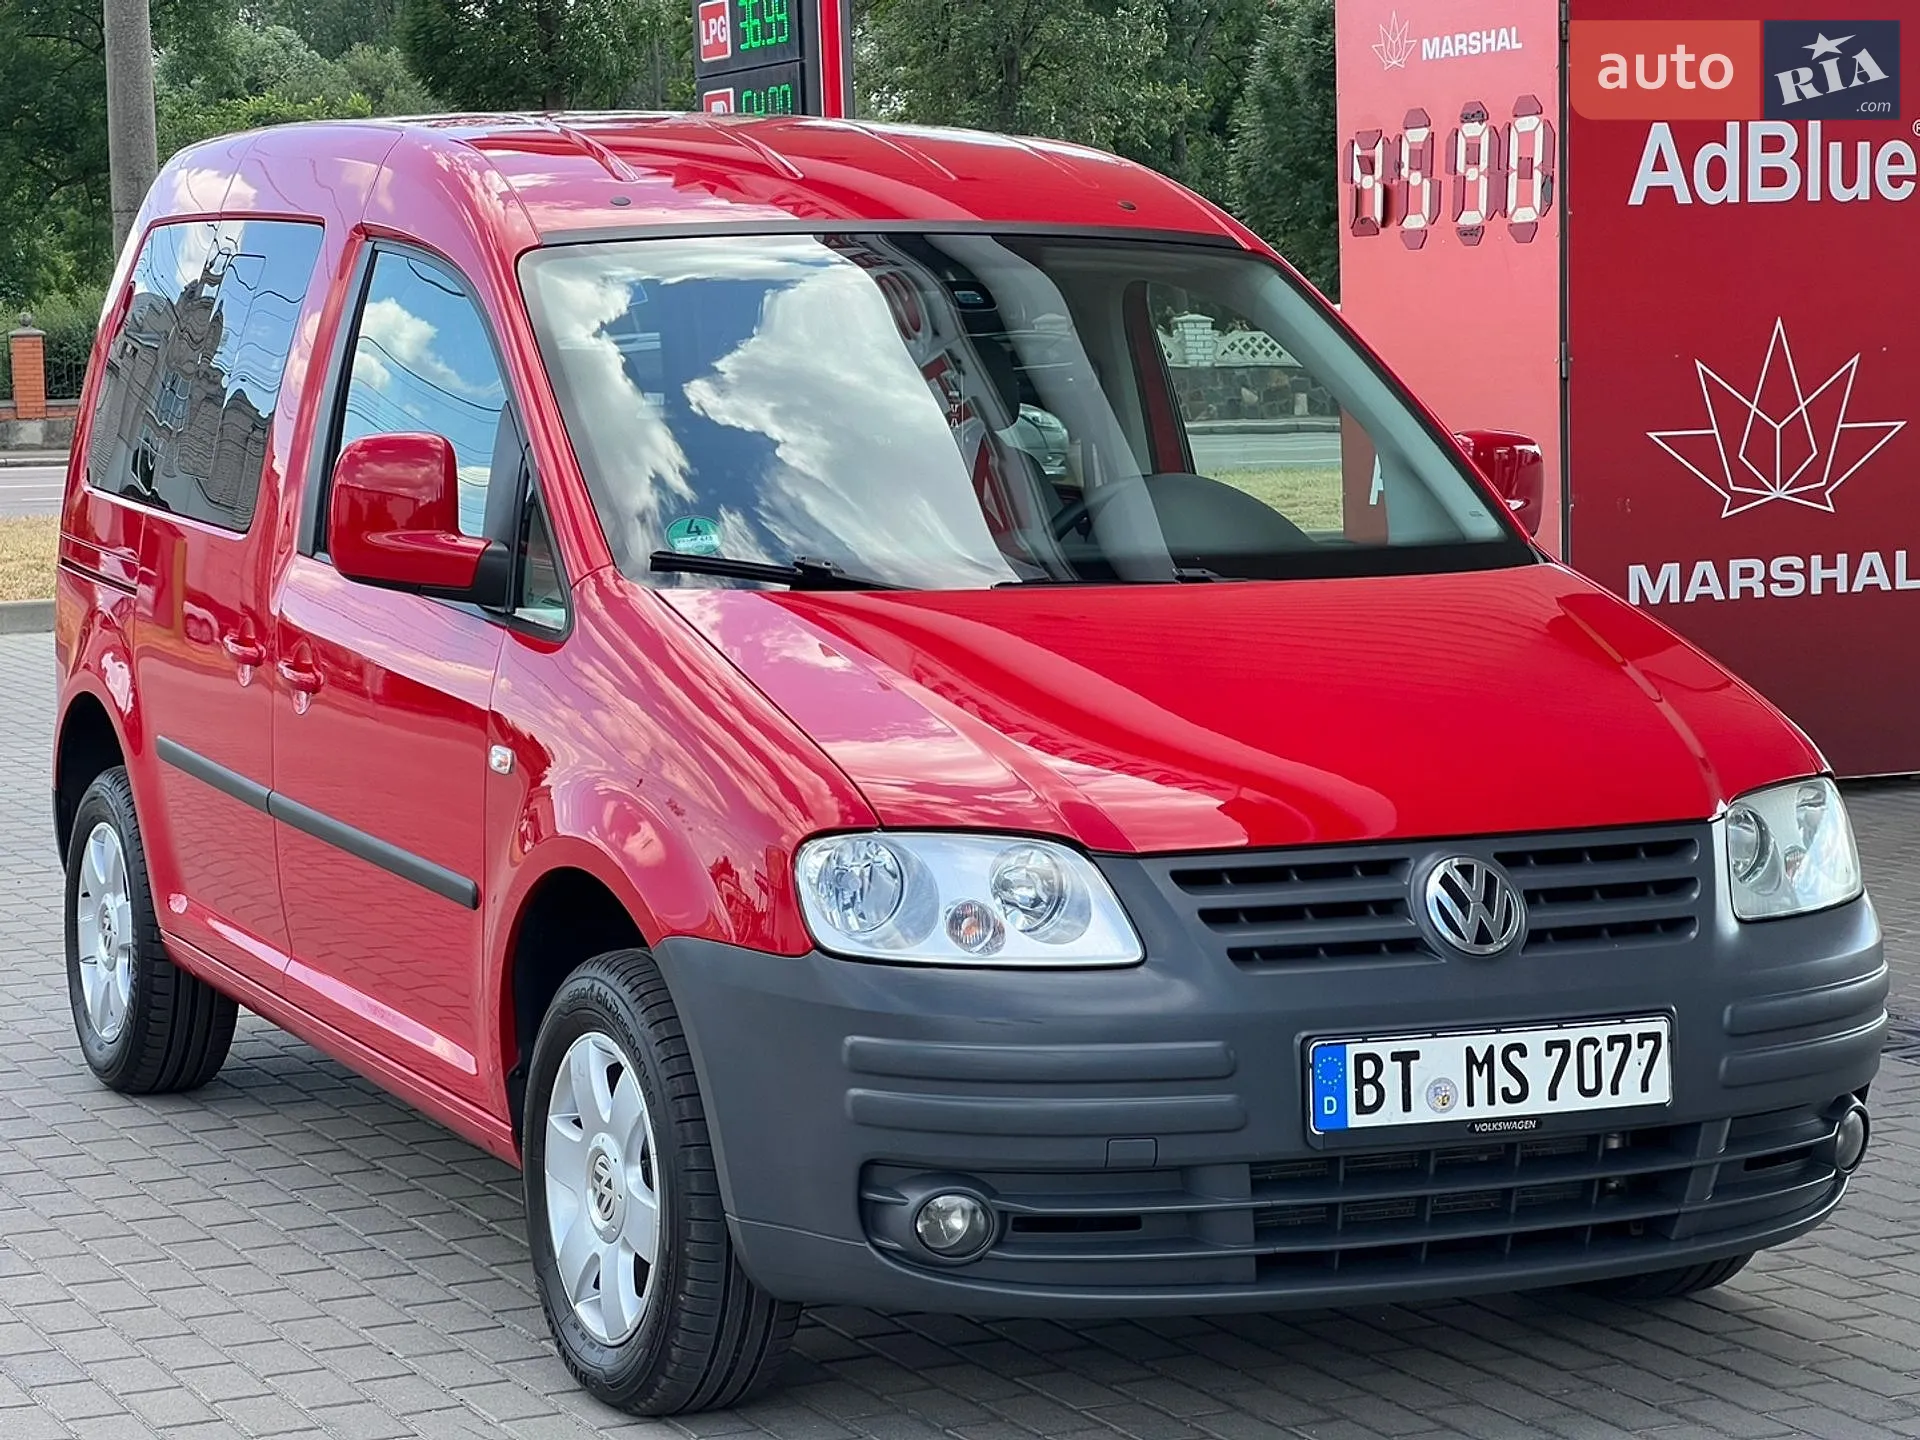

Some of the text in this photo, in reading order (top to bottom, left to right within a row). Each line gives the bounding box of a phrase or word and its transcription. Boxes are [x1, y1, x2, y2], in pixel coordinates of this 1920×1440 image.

[702, 16, 726, 46] LPG
[1421, 26, 1522, 61] MARSHAL
[1627, 120, 1917, 206] AdBlue
[686, 518, 703, 536] 4
[1627, 550, 1920, 605] MARSHAL
[1323, 1031, 1663, 1116] D BT MS 7077
[1474, 1119, 1537, 1132] VOLKSWAGEN
